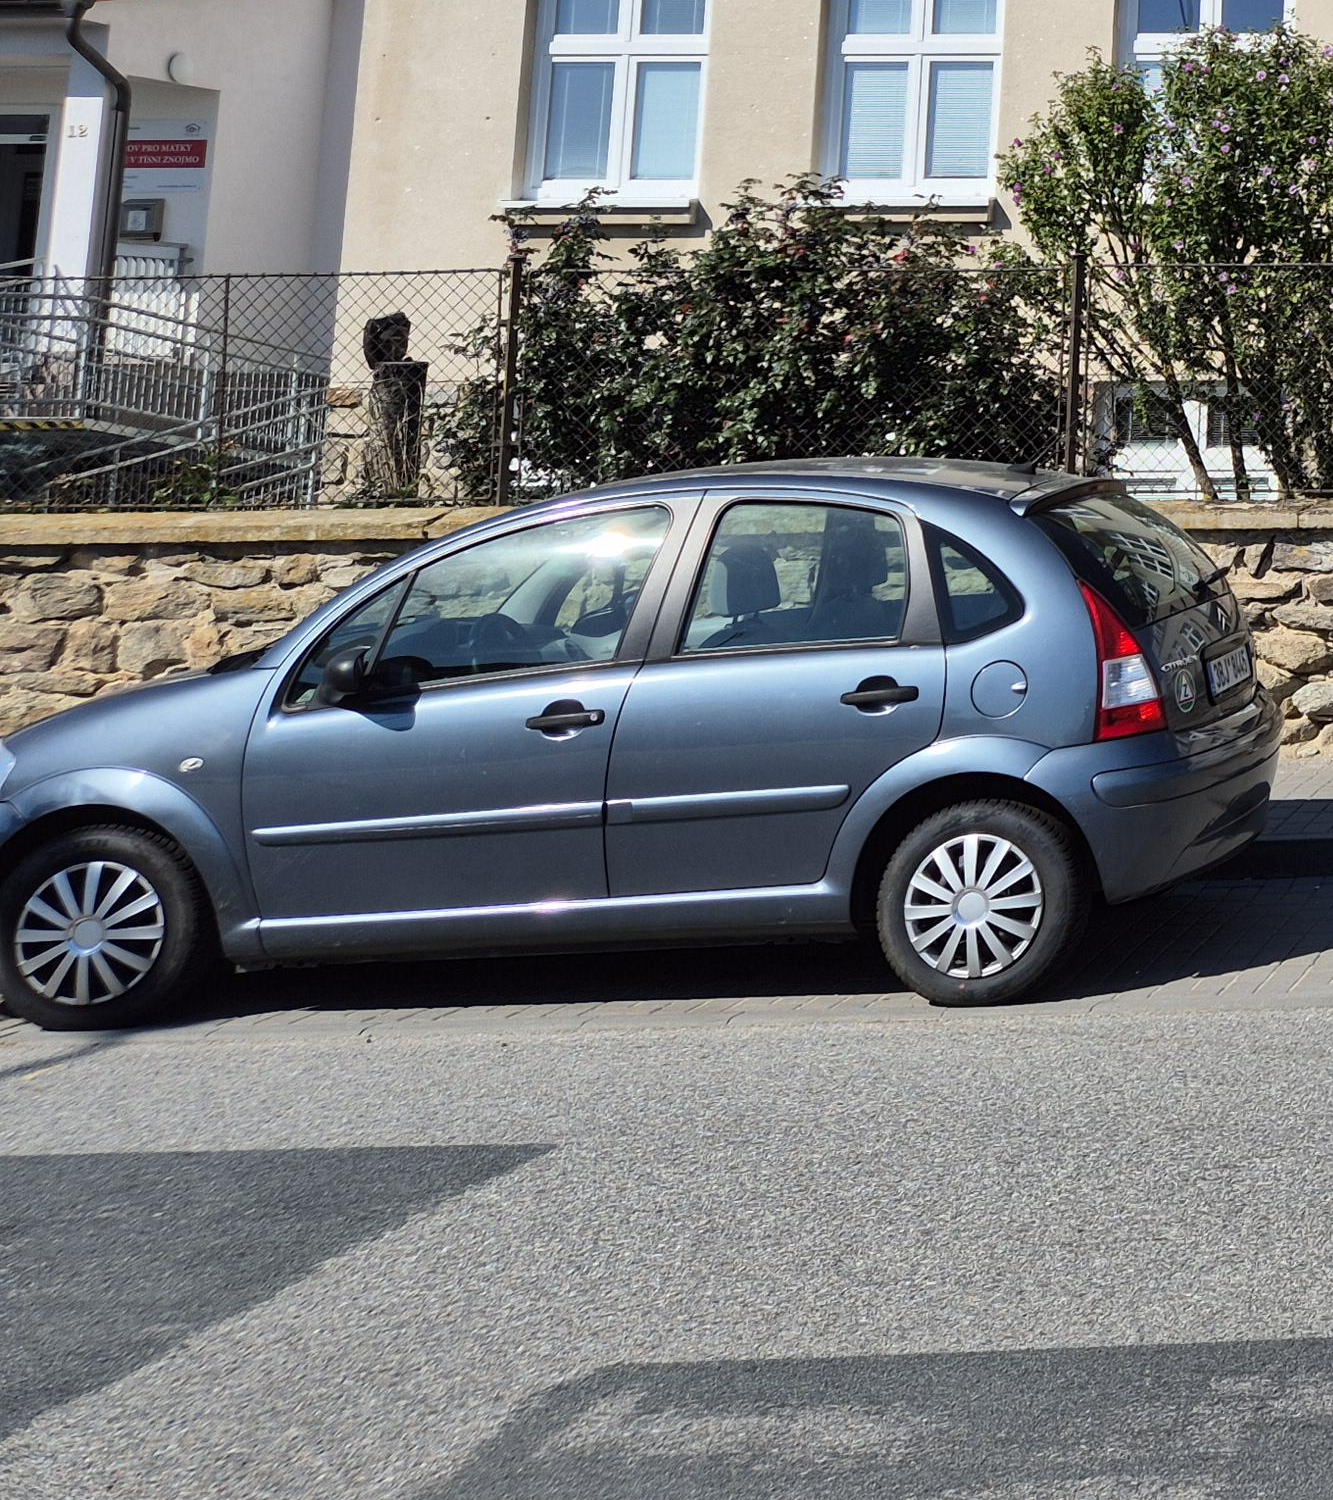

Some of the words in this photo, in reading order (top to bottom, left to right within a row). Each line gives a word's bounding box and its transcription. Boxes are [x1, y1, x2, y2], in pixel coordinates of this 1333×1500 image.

[67, 124, 88, 138] 12
[127, 144, 140, 152] OV
[142, 144, 159, 152] PRO
[161, 143, 192, 152] MATKY
[162, 155, 200, 164] ZNOJMO
